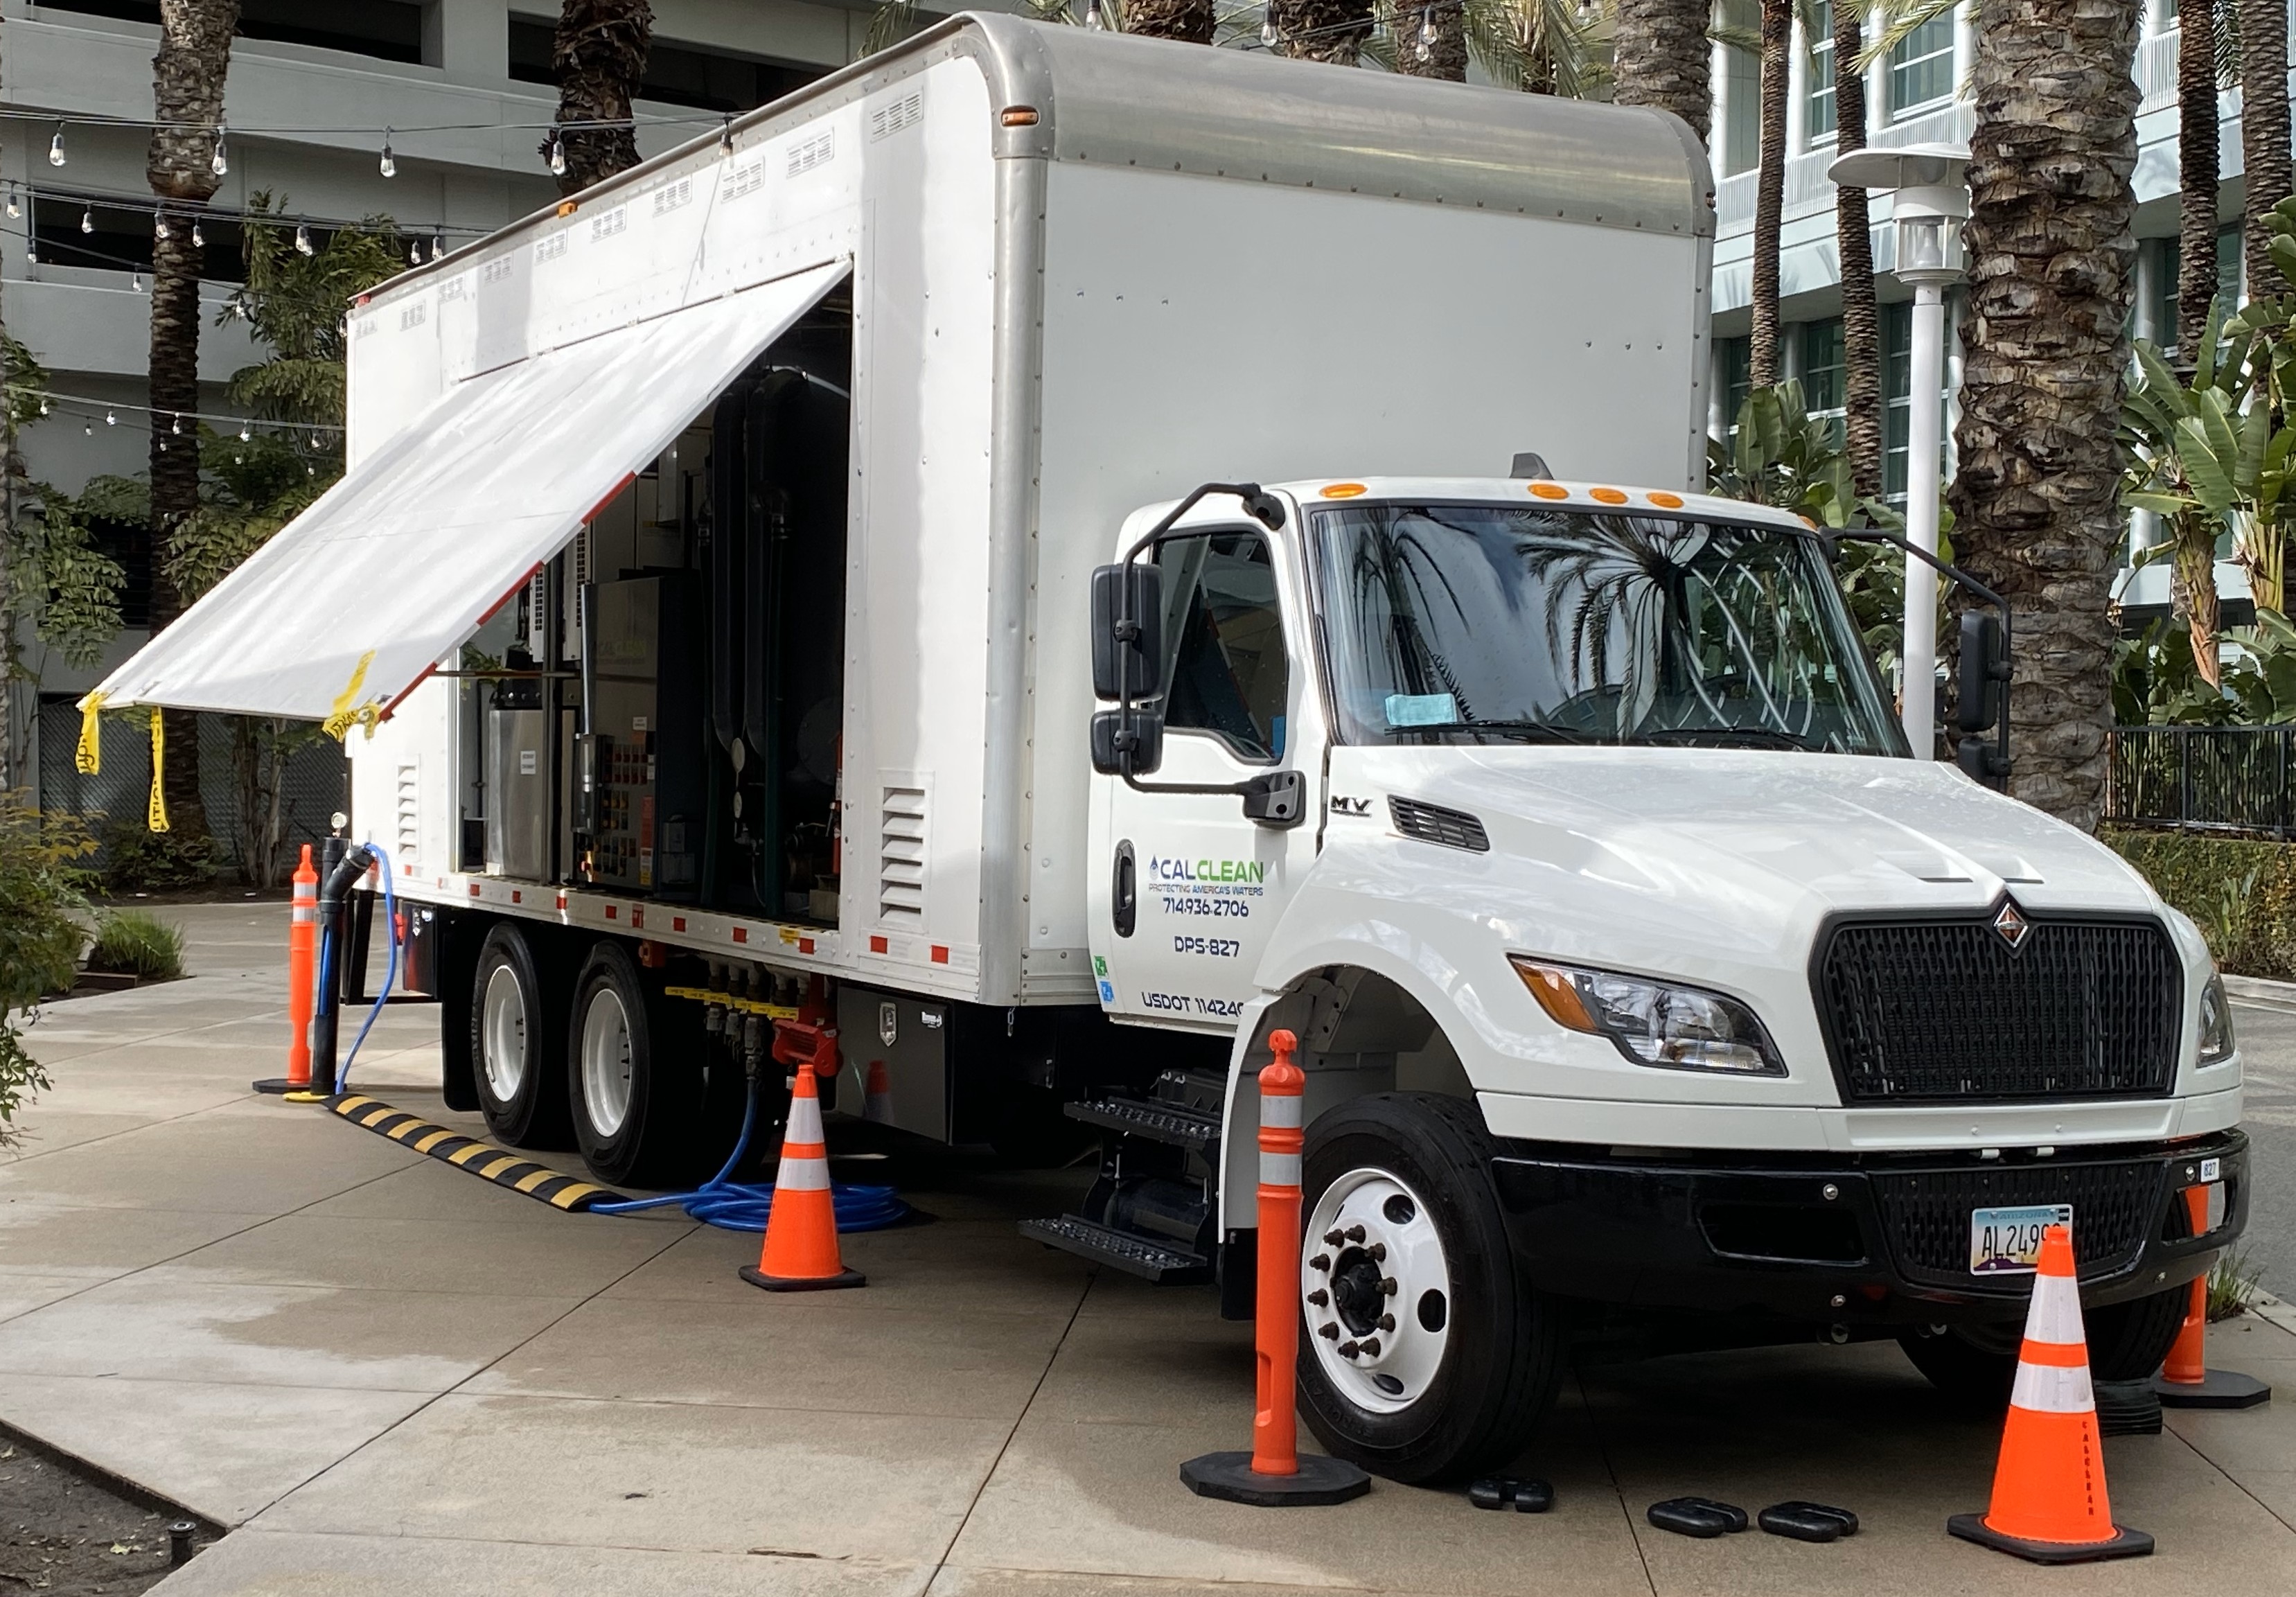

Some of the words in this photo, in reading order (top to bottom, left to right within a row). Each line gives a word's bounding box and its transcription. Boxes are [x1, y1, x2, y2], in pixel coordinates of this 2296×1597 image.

[1330, 795, 1372, 811] MV
[1160, 859, 1263, 883] CALCLEAN
[1149, 883, 1190, 893] PROTECTING
[1192, 885, 1230, 894] AMERICA'S
[1232, 886, 1263, 896] WATERS
[1163, 897, 1248, 917] 714.936.2706
[1174, 935, 1239, 958] DPS-827
[1142, 991, 1190, 1012] USDOT
[2204, 1162, 2216, 1177] 827
[1982, 1222, 2061, 1260] AL249
